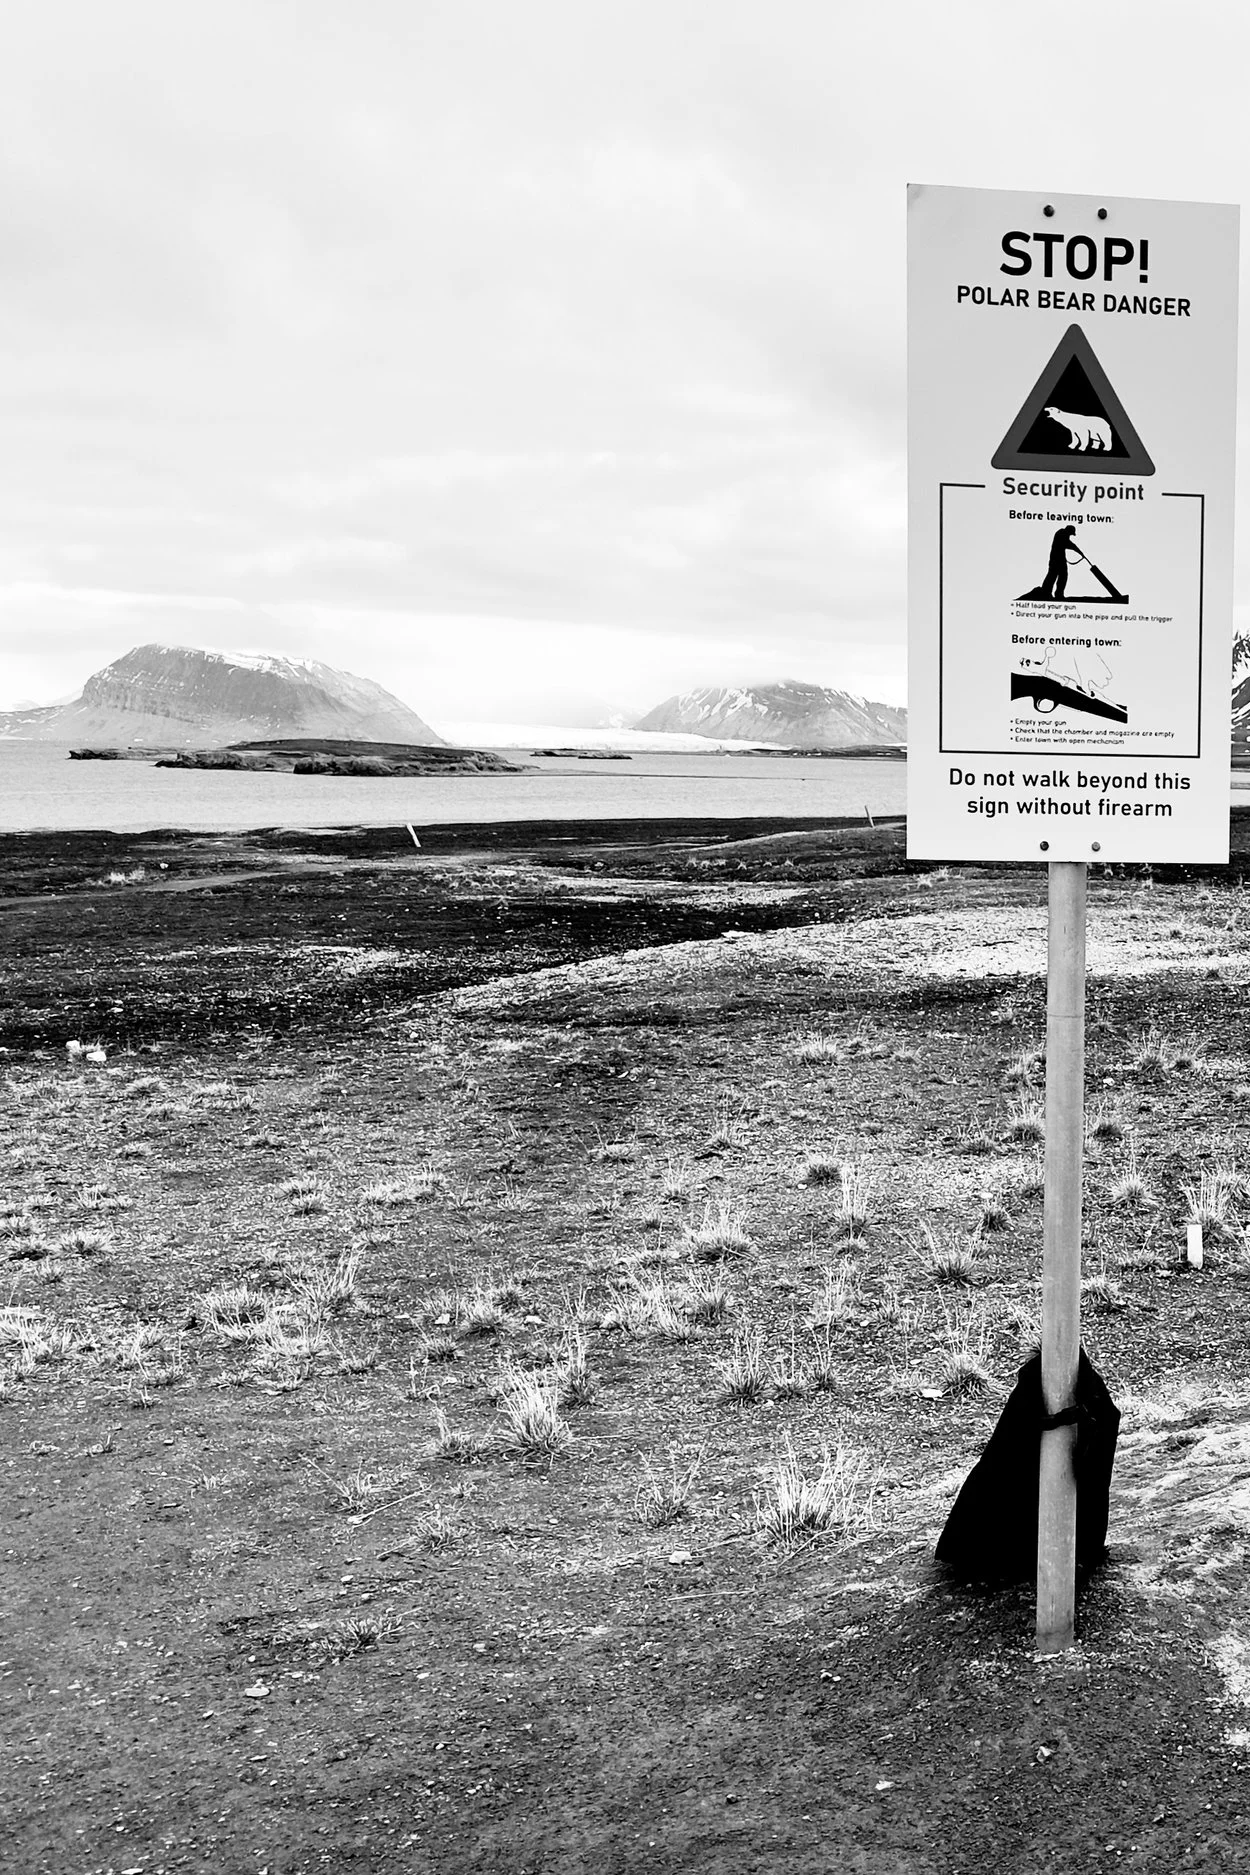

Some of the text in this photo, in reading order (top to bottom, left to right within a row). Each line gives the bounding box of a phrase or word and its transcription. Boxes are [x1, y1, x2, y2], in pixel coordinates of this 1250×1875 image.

[1000, 231, 1148, 283] STOP!
[957, 285, 1190, 317] POLAR BEAR DANGER
[1003, 477, 1144, 503] Security point
[1009, 510, 1114, 524] Before leaving town:
[1012, 634, 1122, 648] Before entering town:
[1015, 718, 1036, 726] Empty
[950, 768, 1190, 793] Do not walk beyond this
[967, 796, 1172, 818] sign without firearm
